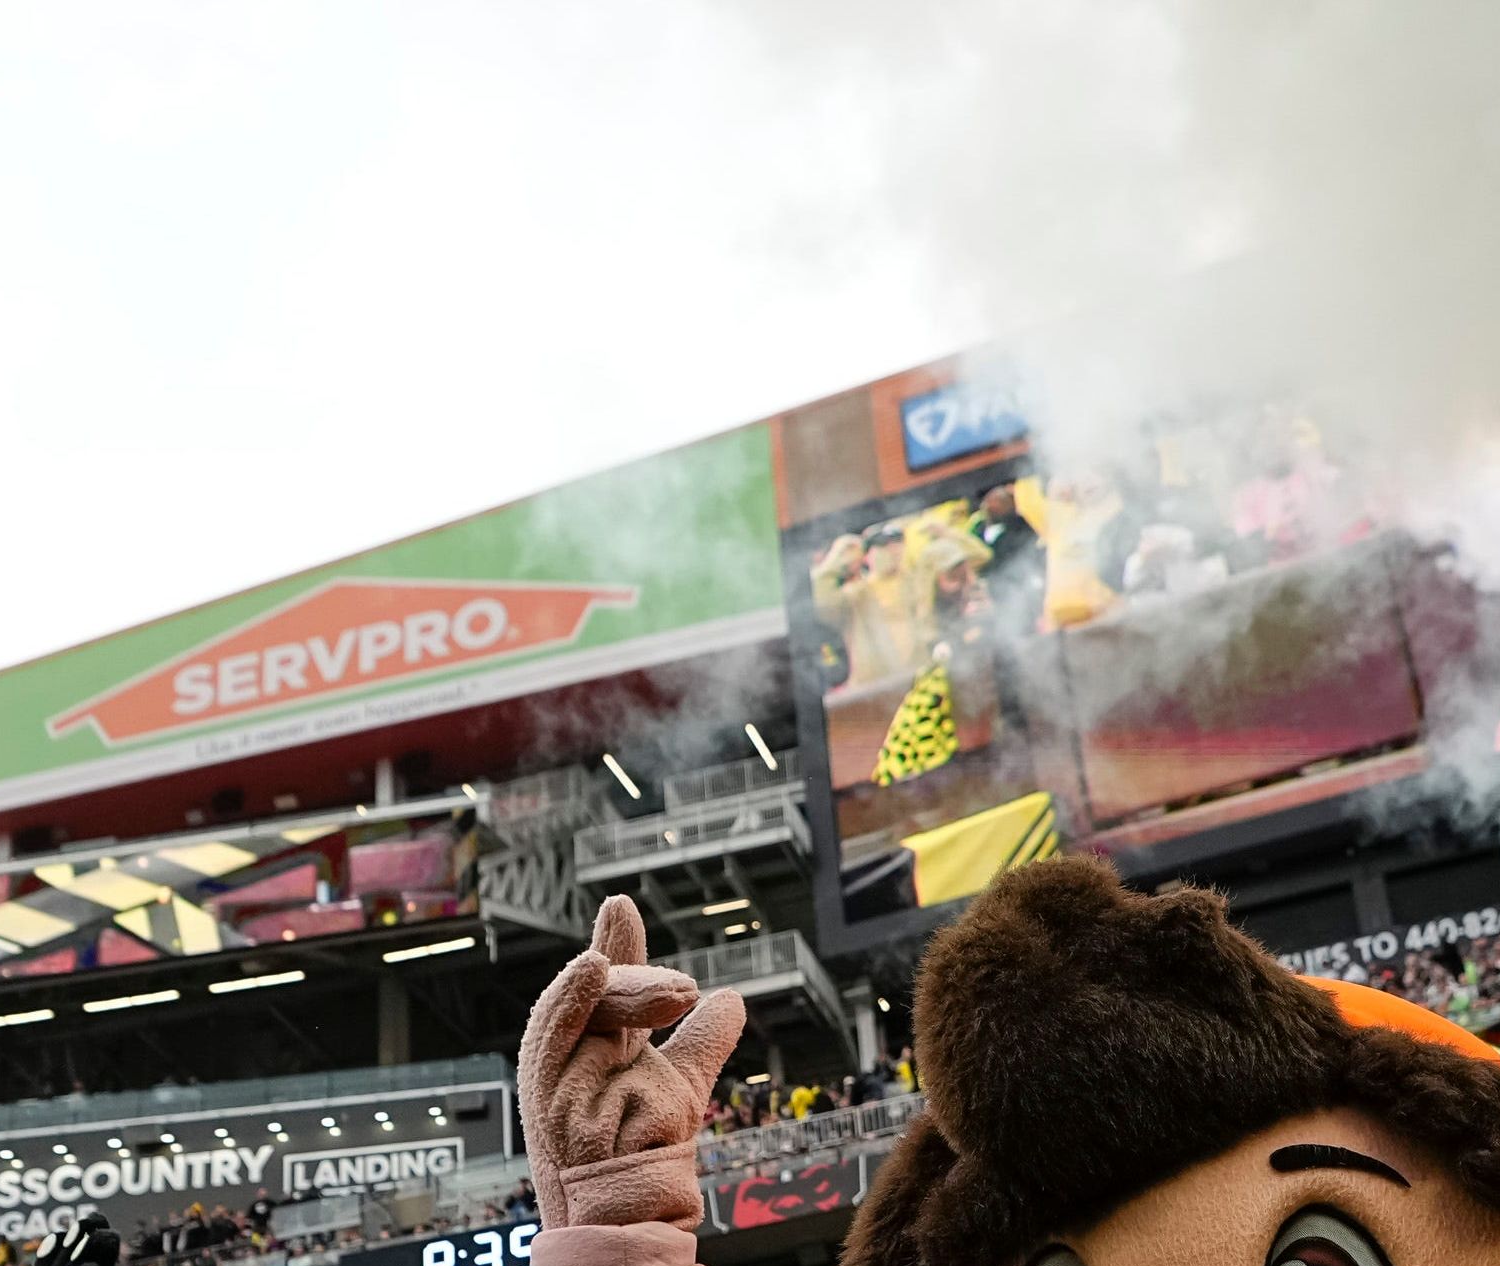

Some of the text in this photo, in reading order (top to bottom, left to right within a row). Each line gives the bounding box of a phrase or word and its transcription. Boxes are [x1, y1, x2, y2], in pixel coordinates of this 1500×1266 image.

[172, 598, 509, 716] SERVPRO
[1353, 931, 1398, 963] TO
[293, 1148, 454, 1191] LANDING
